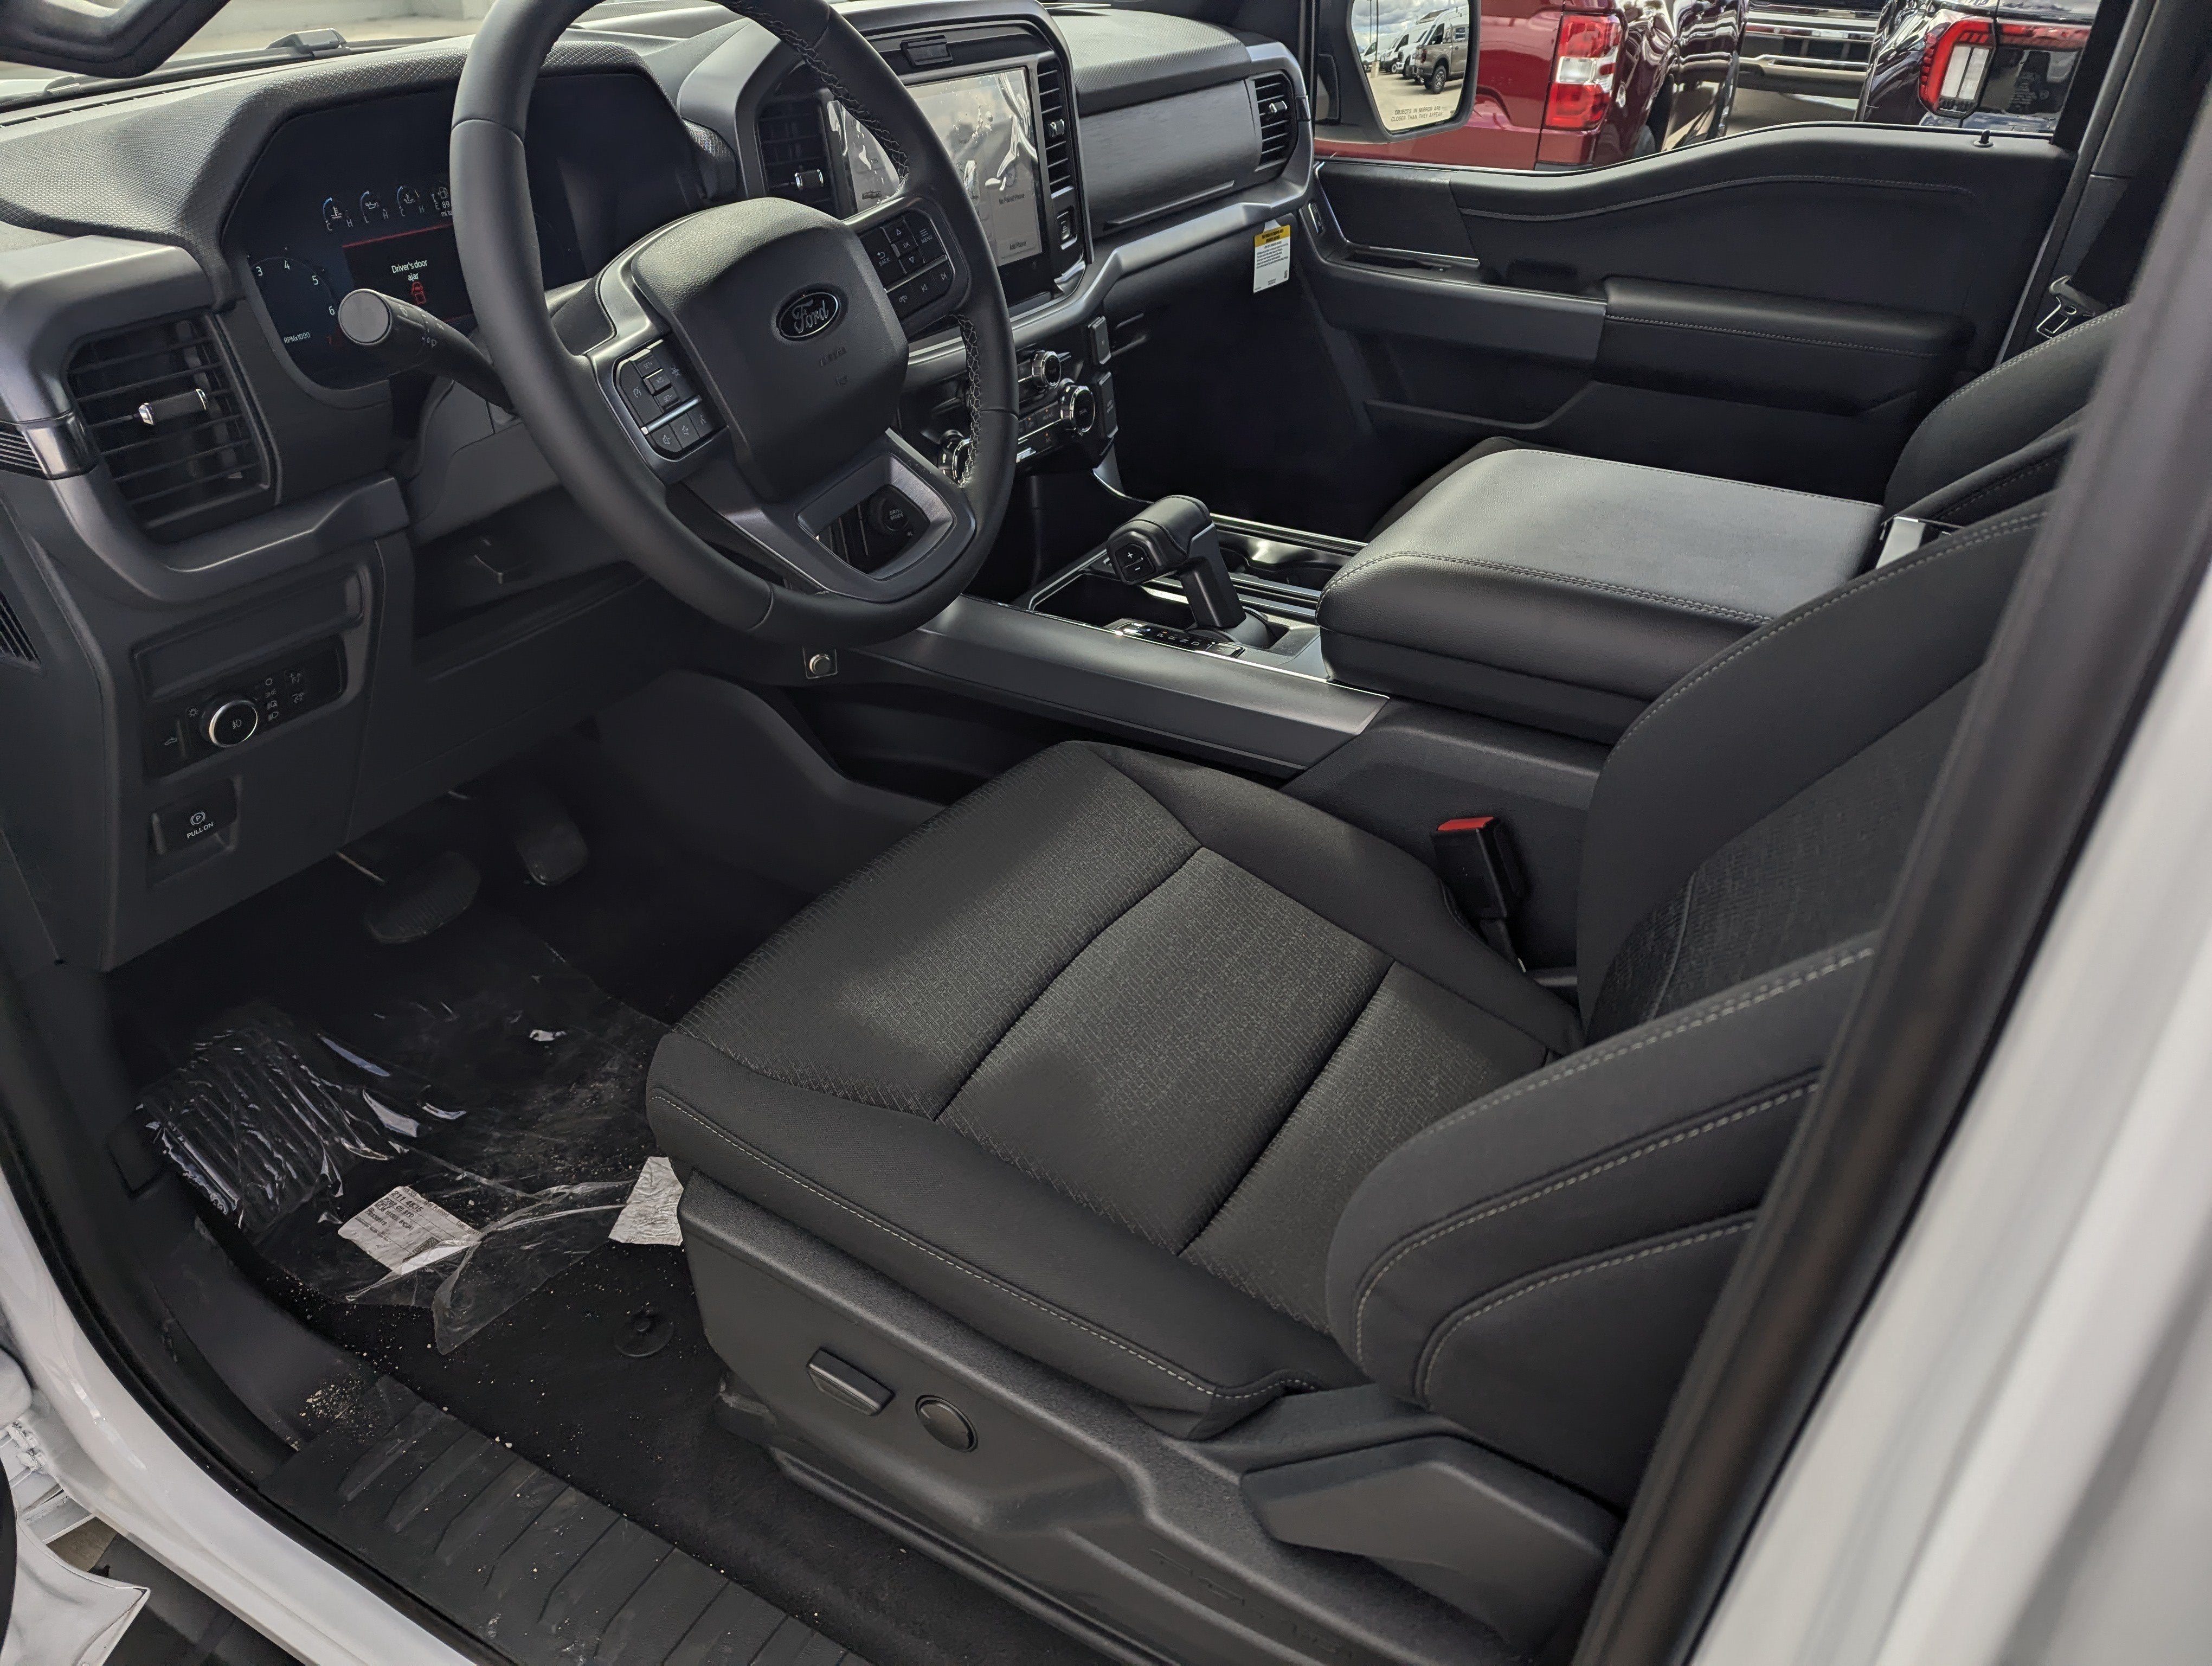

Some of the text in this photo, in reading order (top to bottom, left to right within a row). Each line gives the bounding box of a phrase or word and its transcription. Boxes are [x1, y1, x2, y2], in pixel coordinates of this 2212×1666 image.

[442, 201, 450, 209] 89
[921, 234, 933, 244] MENU
[284, 260, 291, 270] 4
[391, 260, 427, 273] Driver's door
[879, 257, 890, 266] BACK
[255, 266, 263, 276] 3
[312, 275, 319, 285] 5
[408, 273, 419, 281] ajar
[329, 305, 335, 315] 6
[792, 299, 829, 334] Ford
[187, 822, 214, 839] PULL ON
[391, 1190, 407, 1201] 211
[384, 1197, 397, 1207] P702
